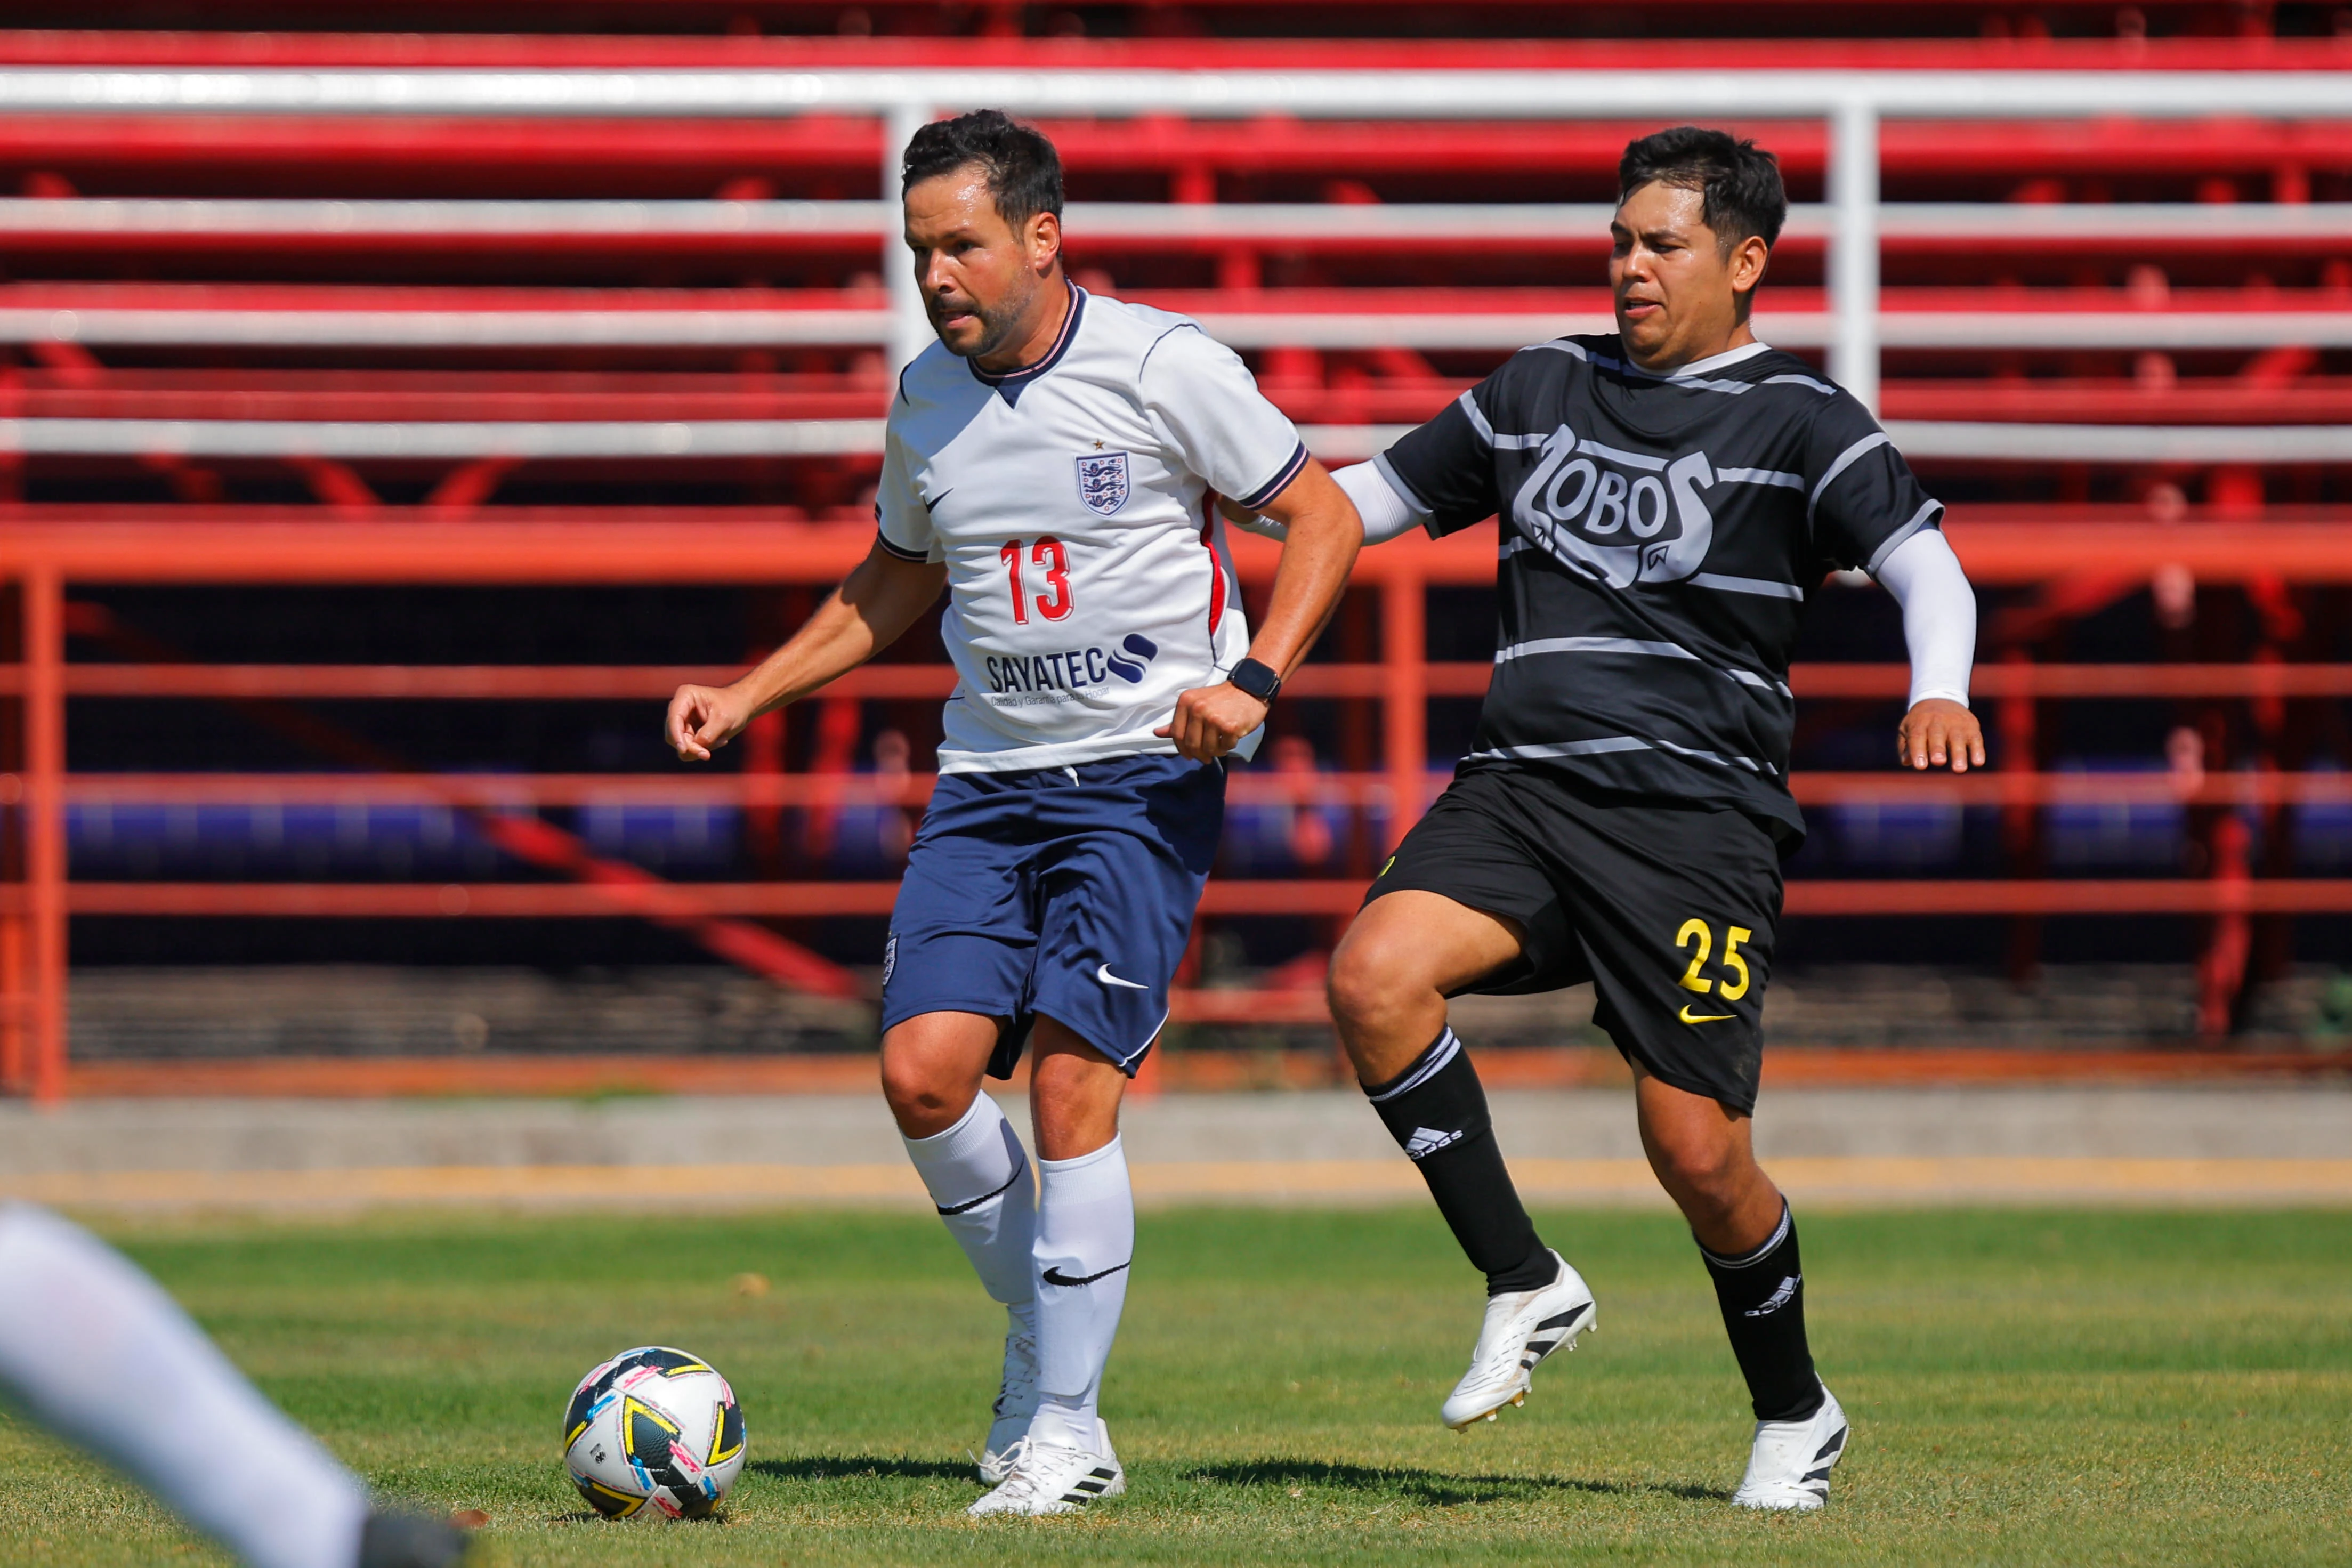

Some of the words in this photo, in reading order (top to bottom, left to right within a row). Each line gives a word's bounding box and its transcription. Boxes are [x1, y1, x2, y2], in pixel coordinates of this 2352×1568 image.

[1513, 423, 1714, 584] LOBOS
[1000, 536, 1074, 625] 13
[987, 647, 1106, 693] SAYATEC
[991, 696, 1017, 706] Calidad
[1018, 698, 1023, 708] y
[1057, 693, 1075, 705] para
[1085, 686, 1110, 699] Hogar
[1676, 918, 1752, 1000] 25
